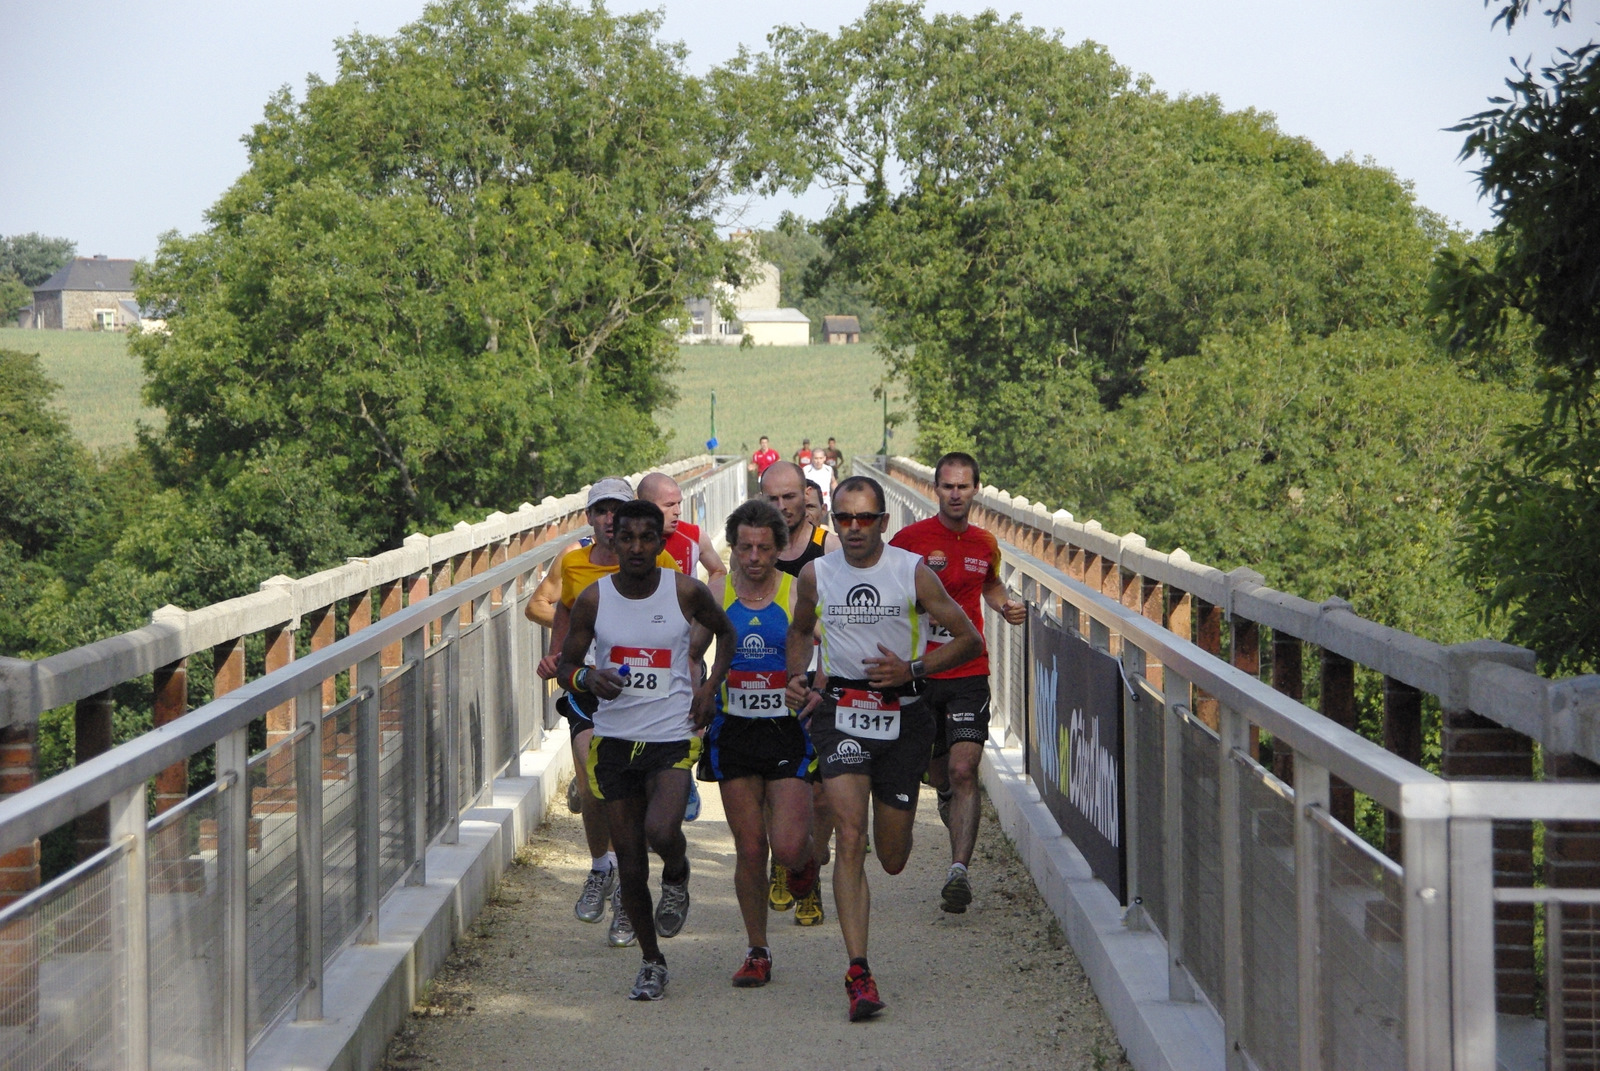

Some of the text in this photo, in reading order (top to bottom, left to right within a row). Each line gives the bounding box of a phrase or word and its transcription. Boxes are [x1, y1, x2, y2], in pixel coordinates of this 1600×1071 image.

[829, 605, 900, 616] ENDURANCE
[848, 615, 880, 624] SHOP
[624, 656, 649, 667] PUMA
[741, 681, 767, 689] PUMA
[739, 693, 783, 710] 1253
[852, 699, 878, 710] PUMA
[848, 712, 895, 732] 1317
